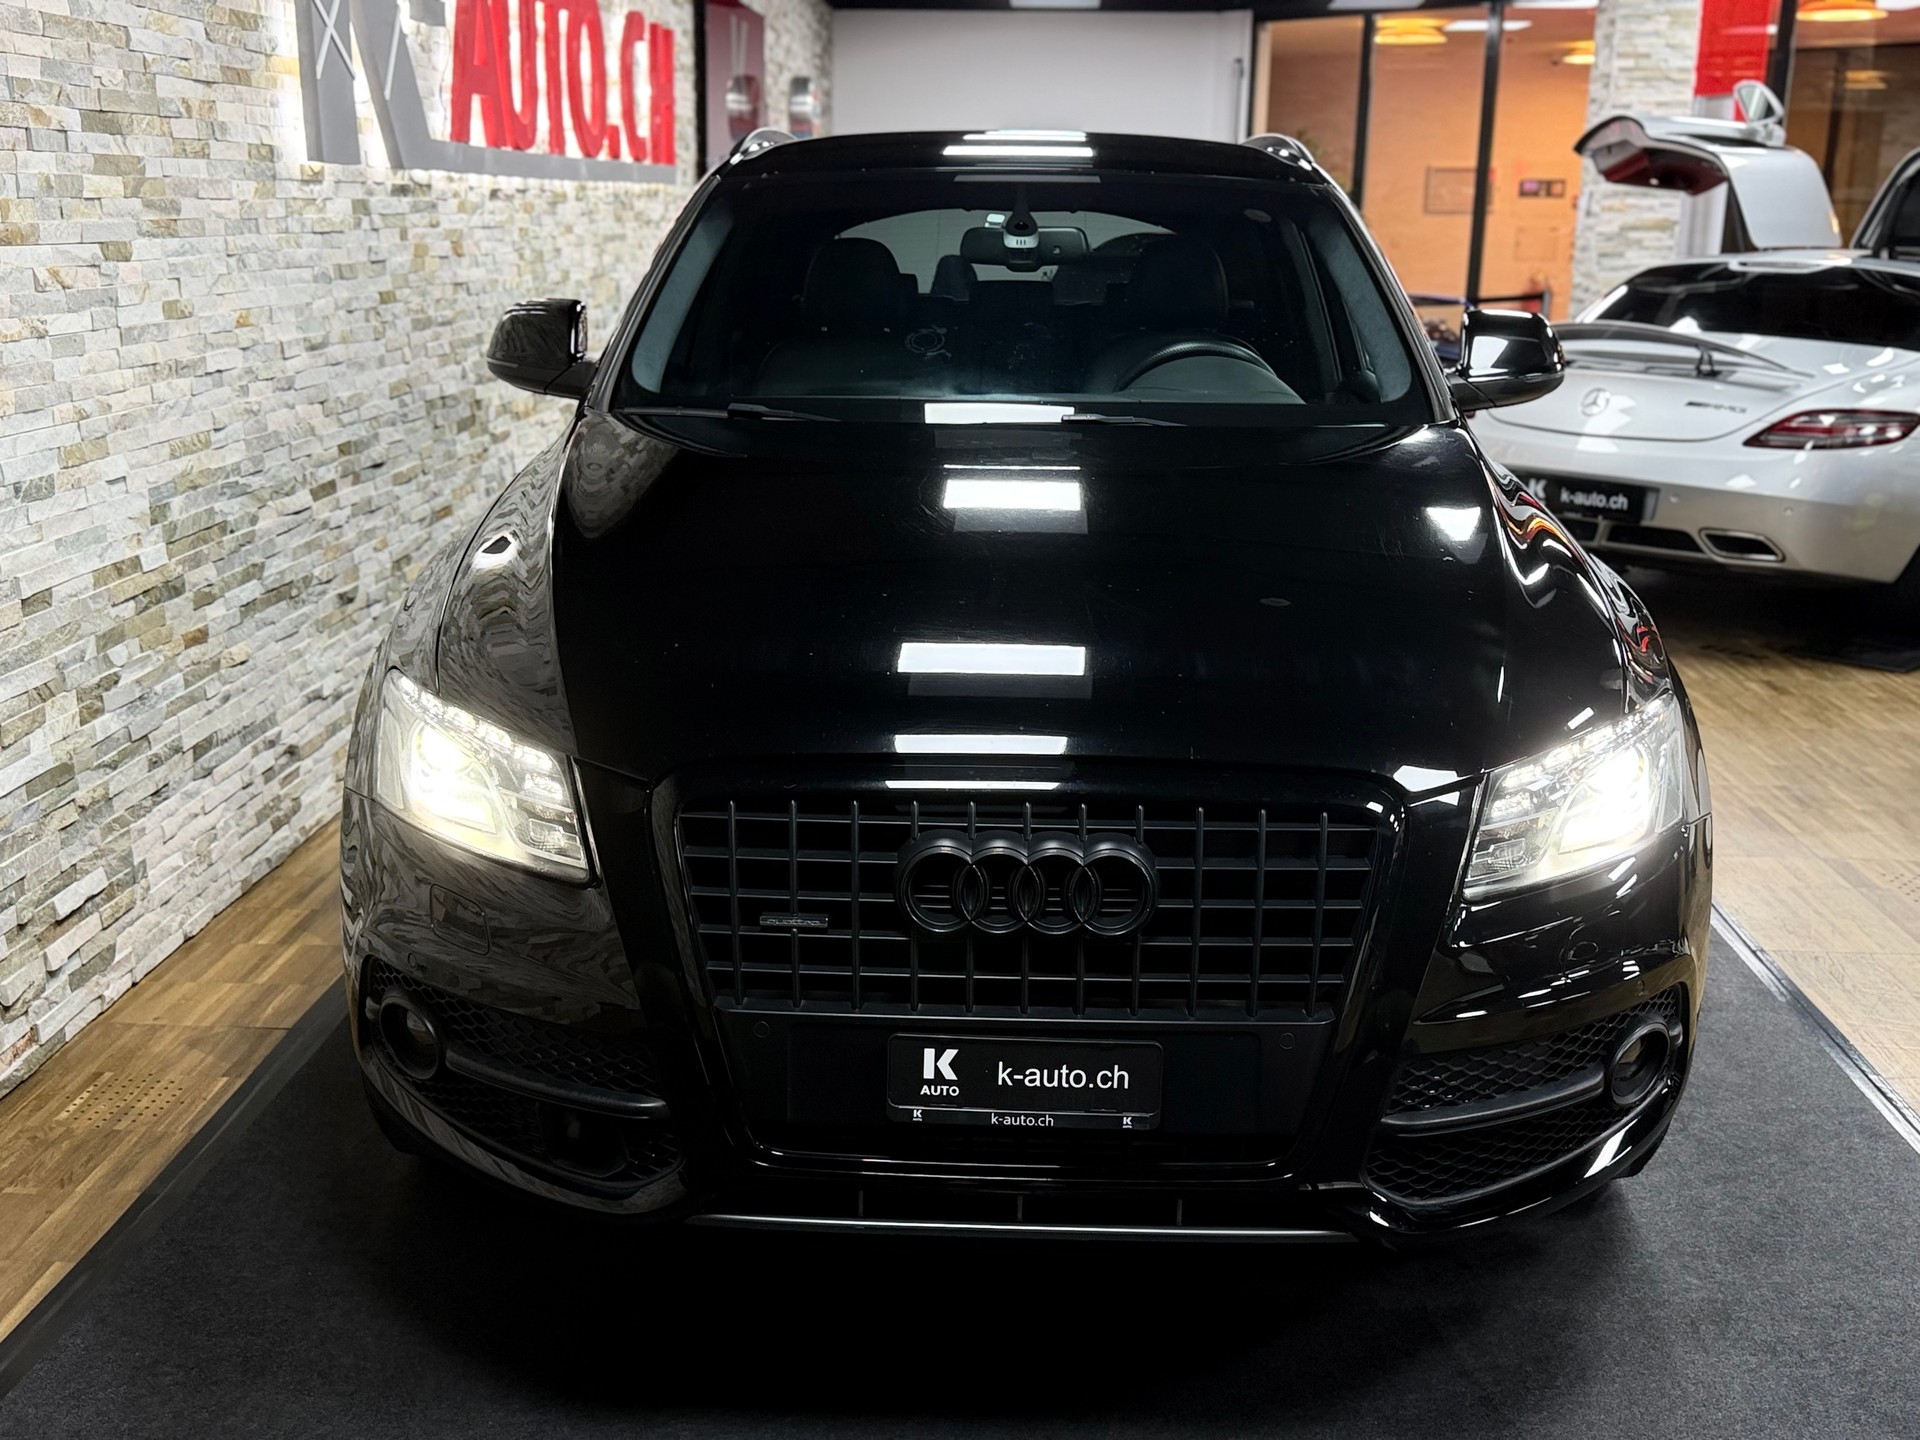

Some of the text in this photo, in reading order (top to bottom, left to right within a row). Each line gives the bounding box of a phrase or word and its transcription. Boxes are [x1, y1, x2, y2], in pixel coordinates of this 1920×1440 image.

[1560, 487, 1629, 511] k-auto.ch
[923, 1048, 959, 1080] K
[997, 1061, 1130, 1089] k-auto.ch
[920, 1085, 960, 1097] AUTO
[913, 1109, 923, 1118] K
[991, 1112, 1054, 1127] k-auto.ch
[1122, 1116, 1132, 1125] K
